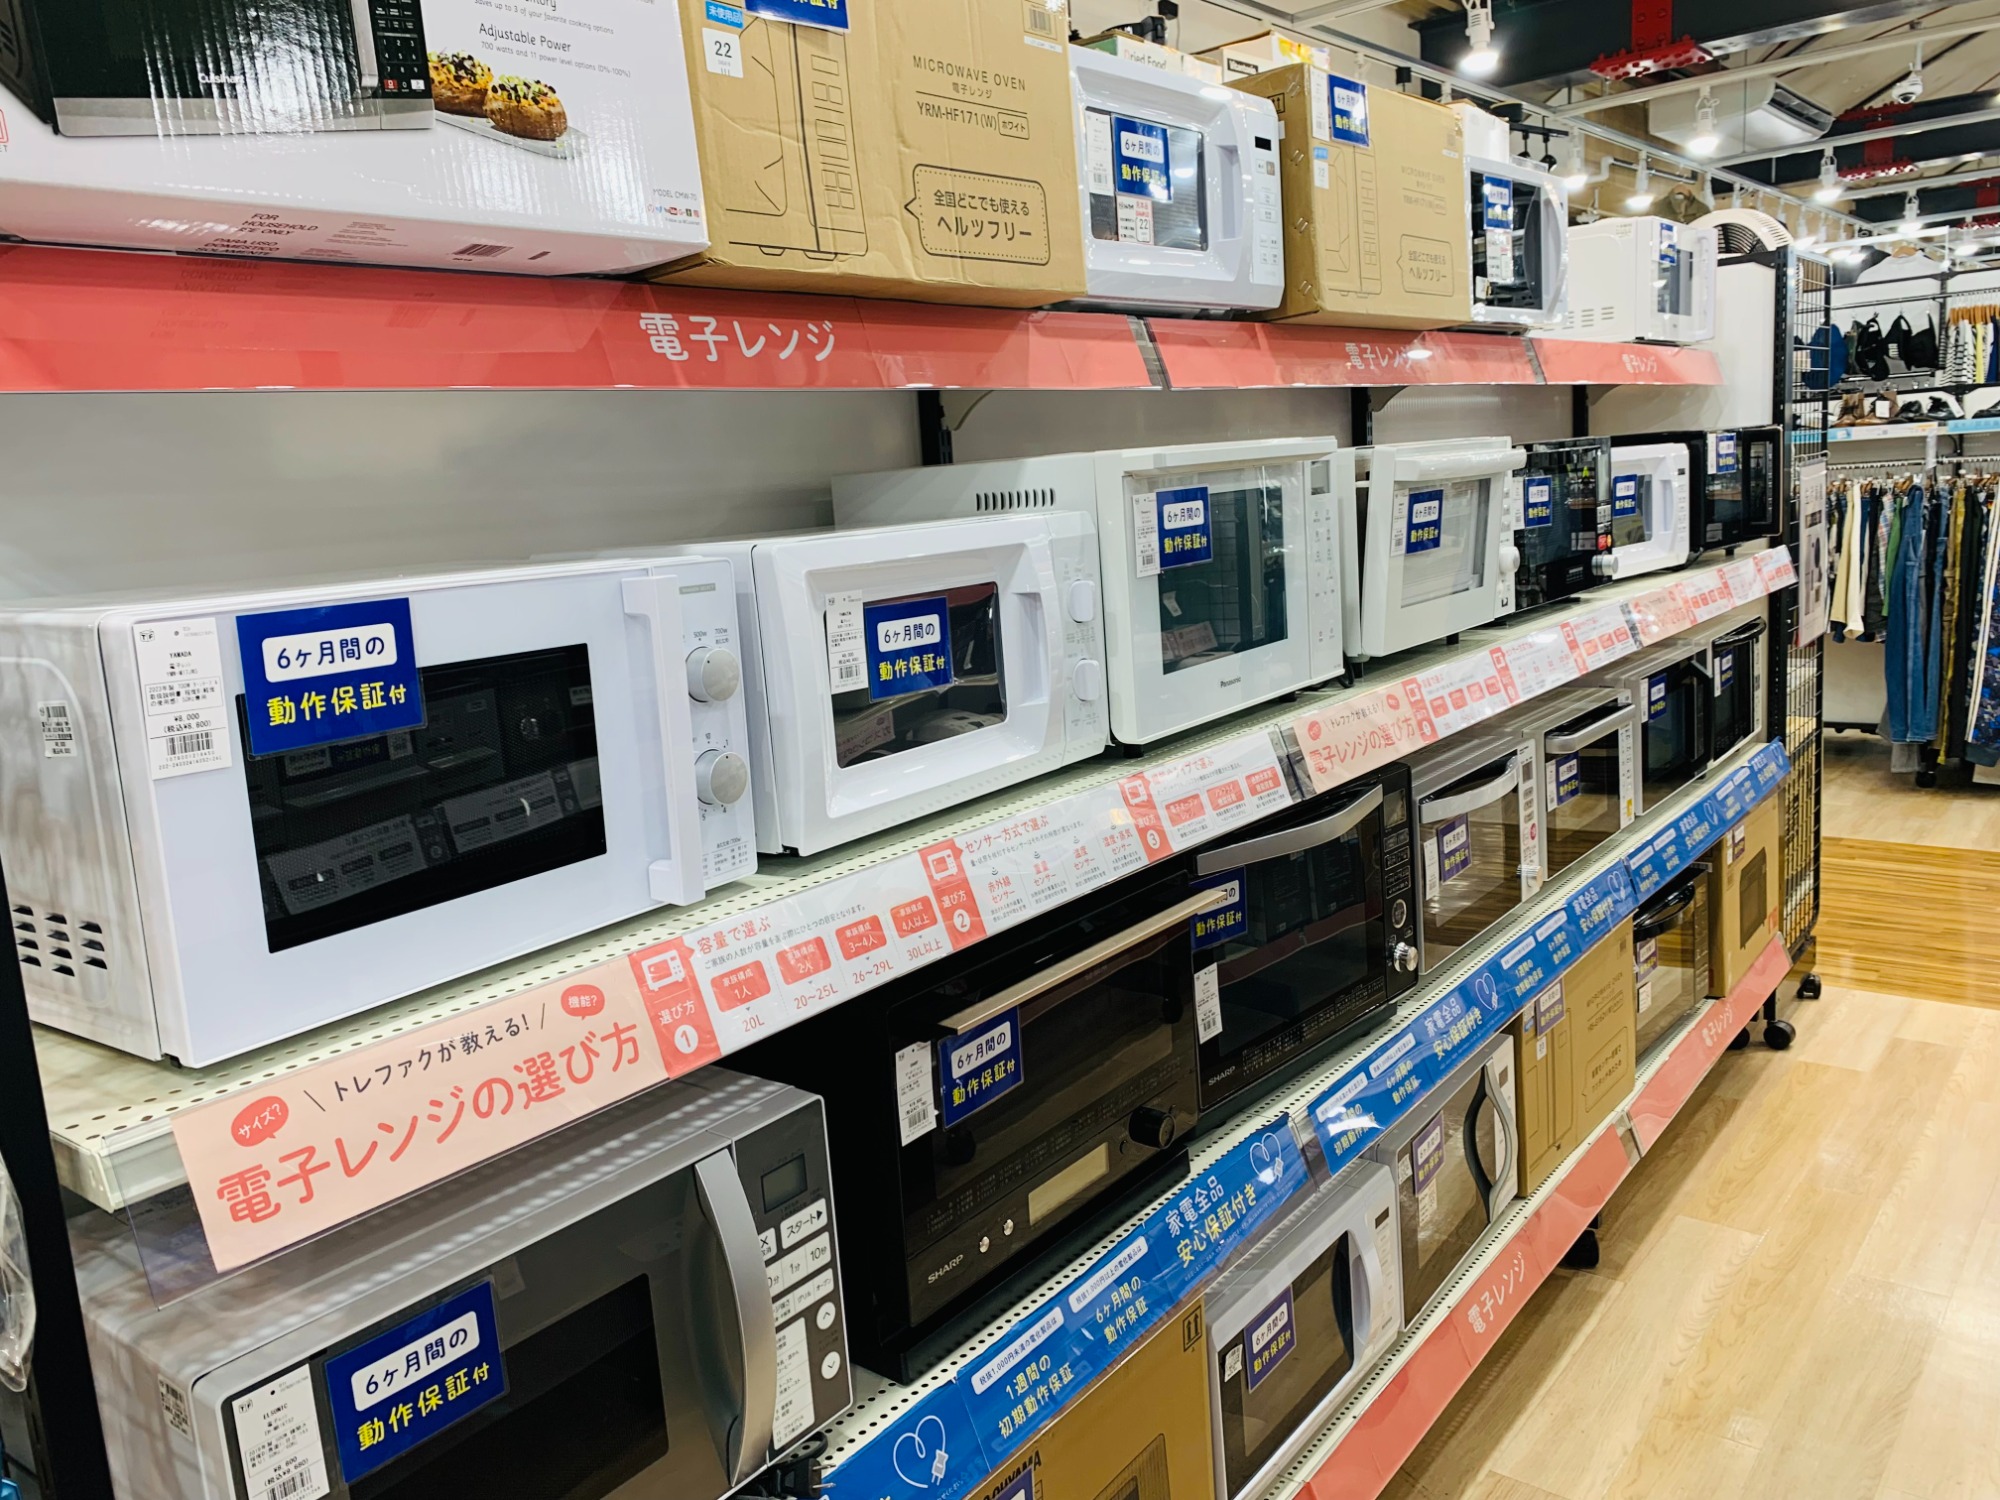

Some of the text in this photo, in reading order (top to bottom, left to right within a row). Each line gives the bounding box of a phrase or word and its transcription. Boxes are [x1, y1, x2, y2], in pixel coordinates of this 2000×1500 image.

[707, 5, 742, 25] 未使用品
[478, 22, 571, 52] Adjustable Power
[714, 39, 732, 59] 22
[481, 41, 494, 51] 700
[496, 45, 514, 55] watts
[516, 48, 528, 58] and
[539, 53, 557, 65] power
[559, 56, 573, 67] level
[575, 60, 596, 72] options
[913, 55, 1026, 92] MICROWAVE OVEN
[952, 82, 992, 99] 電子レンジ
[916, 101, 997, 131] YRM-HF171(W)
[1001, 119, 1026, 133] ホワイト
[933, 189, 1030, 216] 全国どこでも使える
[242, 220, 318, 231] HOUSEHOLD
[251, 213, 279, 221] FOR
[937, 216, 1032, 242] ヘルツフリー
[1138, 218, 1149, 231] 22
[639, 311, 836, 363] 電子レンジ
[1621, 353, 1657, 374] 電子レンジ
[1167, 507, 1201, 522] 6ヶ月間の
[1164, 533, 1207, 554] 動作保証付
[884, 622, 935, 644] 6ヶ月間の
[276, 635, 385, 671] 6ヶ月間の
[878, 653, 945, 681] 動作保証付
[1220, 675, 1242, 688] Panasonic
[266, 682, 407, 727] 動作保証付
[1309, 715, 1415, 774] 電子レンジの選び方
[965, 815, 1049, 854] センサー方式で選ぶ
[1149, 833, 1157, 845] 3
[1111, 842, 1132, 855] センサー
[1073, 857, 1095, 871] センサー
[988, 876, 1012, 893] 赤外線
[1033, 873, 1057, 887] センサー
[941, 890, 967, 908] 選び方
[992, 890, 1016, 905] センサー
[845, 922, 872, 938] 家族構成
[902, 914, 930, 931] 4人以上
[957, 913, 967, 928] 2
[1196, 910, 1242, 937] 動作保証付
[697, 916, 772, 955] 容量で選ぶ
[906, 938, 943, 961] 30L以上
[722, 968, 754, 987] 家族構成
[797, 960, 815, 974] 2人
[567, 993, 599, 1011] 機能?
[734, 985, 752, 1000] 1人
[658, 1000, 696, 1026] 選び方
[742, 1014, 765, 1033] 20L
[1425, 997, 1461, 1038] 家電全品
[1701, 1002, 1733, 1048] 電子レンジ
[1433, 1007, 1483, 1061] 安心保証付き
[334, 1013, 531, 1103] トレファクが教える!
[957, 1032, 1006, 1069] 6ヶ月間の
[952, 1058, 1015, 1107] 動作保証付
[1208, 1065, 1236, 1087] SHARP
[1386, 1060, 1413, 1088] 6ヶ月間の
[1392, 1075, 1421, 1105] 動作保証
[217, 1021, 641, 1225] 電子レンジの選び方
[238, 1102, 284, 1140] サイズ?
[1165, 1175, 1224, 1239] 家電全品
[786, 1213, 816, 1239] スタート
[1176, 1183, 1257, 1269] 安心保証付き
[927, 1255, 964, 1284] SHARP
[1096, 1276, 1141, 1323] 6ヶ月間の
[1467, 1250, 1525, 1334] 電子レンジ
[1103, 1296, 1149, 1345] 動作保証
[1255, 1310, 1286, 1346] 6ヶ月間の
[365, 1327, 468, 1396] 6ヶ月間の
[979, 1317, 1058, 1386] 税抜1,000円未満の電化製品は
[1253, 1329, 1291, 1374] 動作保証付
[1005, 1354, 1051, 1400] 1週間の
[357, 1362, 491, 1453] 動作保証付
[998, 1362, 1074, 1439] 初期動作保証
